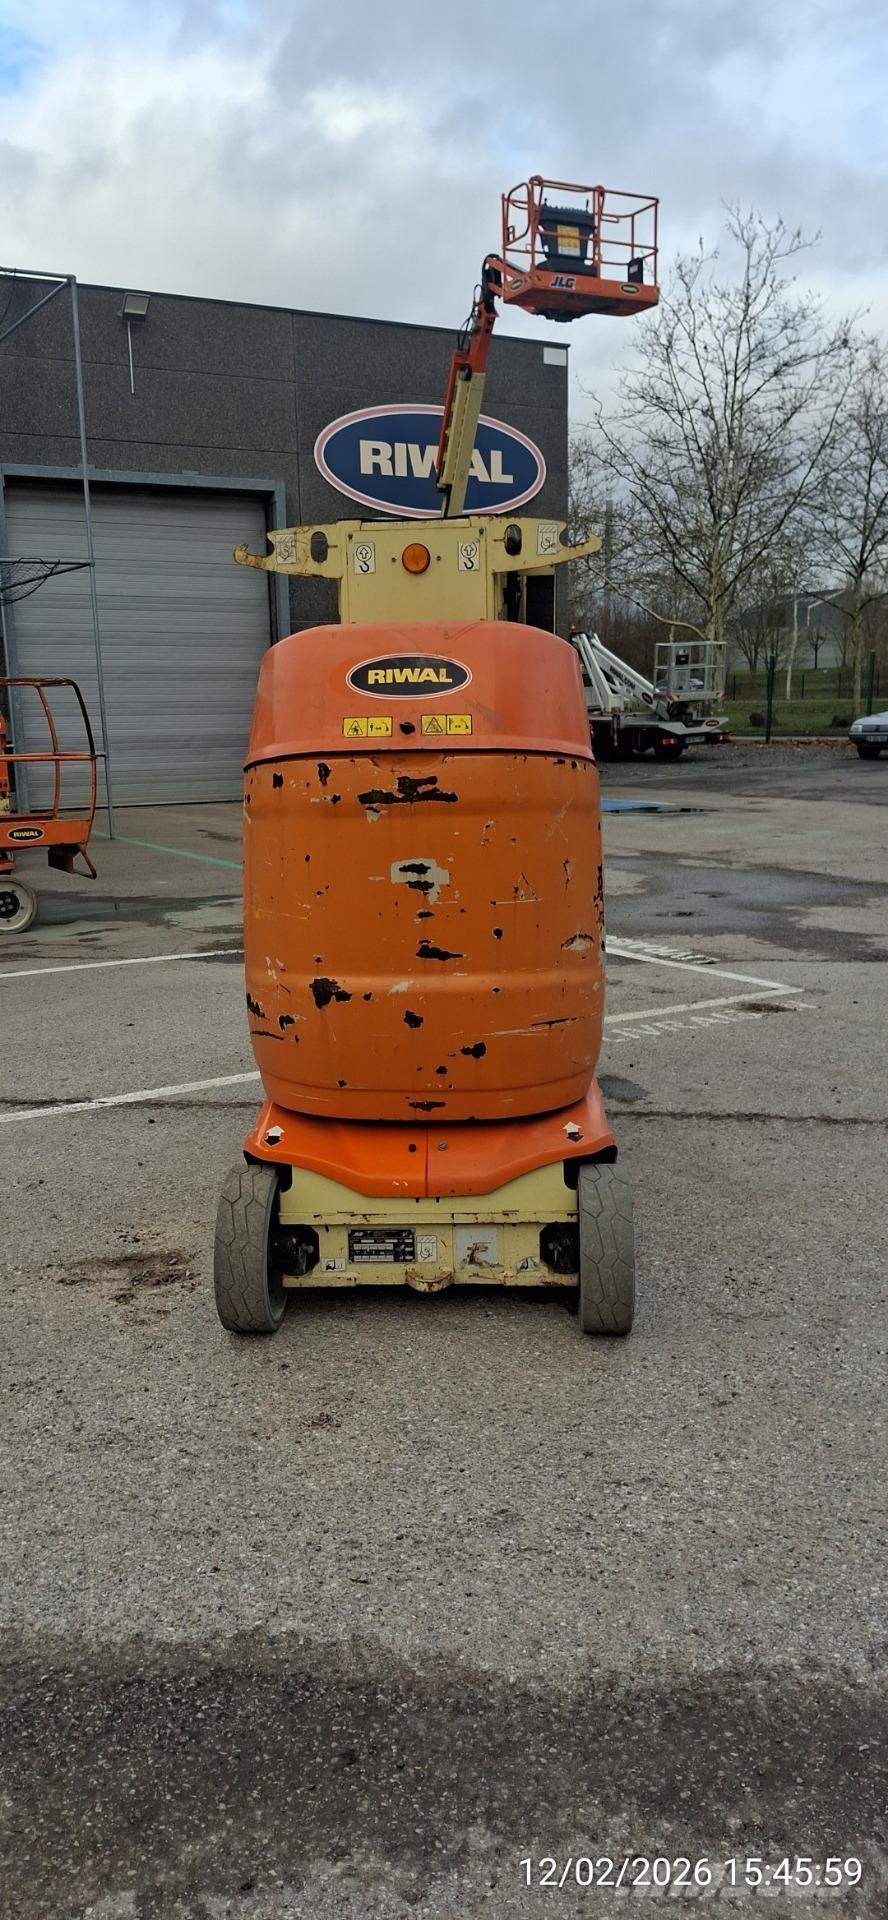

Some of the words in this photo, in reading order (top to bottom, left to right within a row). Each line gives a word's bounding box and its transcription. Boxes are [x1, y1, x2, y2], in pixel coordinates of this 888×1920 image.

[550, 276, 576, 289] JLG
[367, 668, 453, 684] RIWAL
[13, 830, 39, 838] RIWAL
